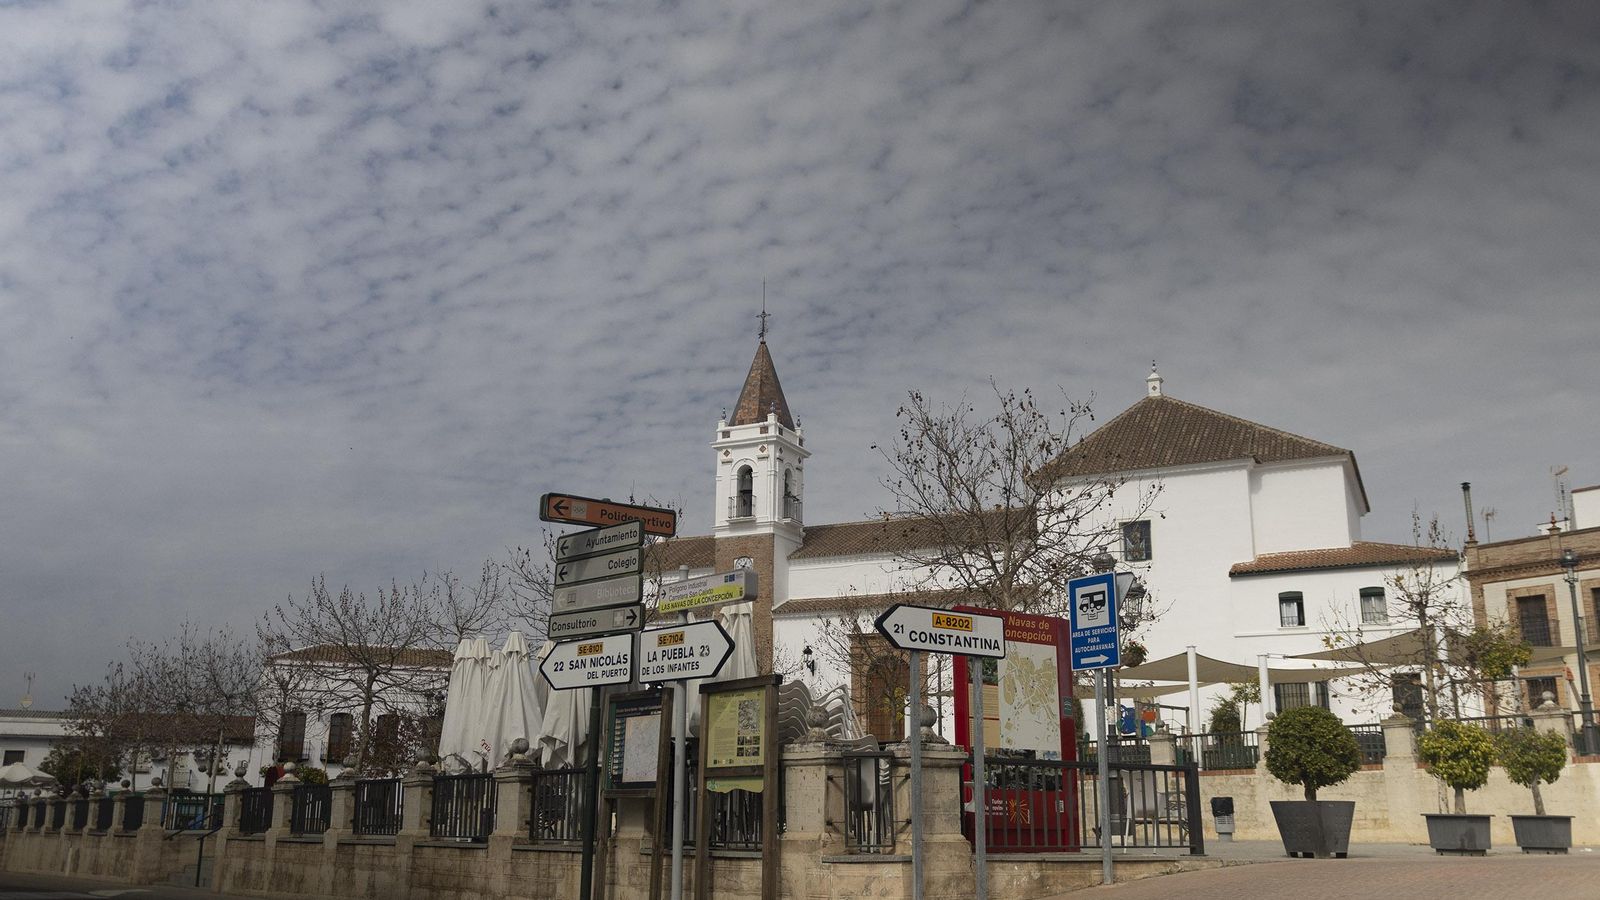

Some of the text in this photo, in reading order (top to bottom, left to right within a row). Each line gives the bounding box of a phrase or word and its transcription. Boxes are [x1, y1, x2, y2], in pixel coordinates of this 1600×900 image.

[585, 529, 638, 548] Ayuntamiento
[608, 556, 637, 571] Colegio
[597, 584, 635, 599] Biblioteca
[671, 601, 687, 609] NAVAS
[700, 592, 733, 604] CONCEPCIÓN
[552, 618, 597, 632] Consultorio
[935, 616, 970, 629] A-8202
[1008, 615, 1050, 630] Navas de
[658, 631, 684, 645] SE-7104
[894, 624, 1000, 650] 21 CONSTANTINA
[1005, 628, 1052, 642] oncepción
[1092, 626, 1115, 635] SERVICIOS
[1075, 642, 1115, 653] AUTOCARAVANAS
[1088, 636, 1100, 644] PARA
[647, 645, 711, 663] LA PUEBLA 23
[554, 652, 628, 672] 22 SAN NICOLÁS
[641, 661, 700, 676] DE LOS INFANTES
[587, 668, 628, 680] DEL PUERTO
